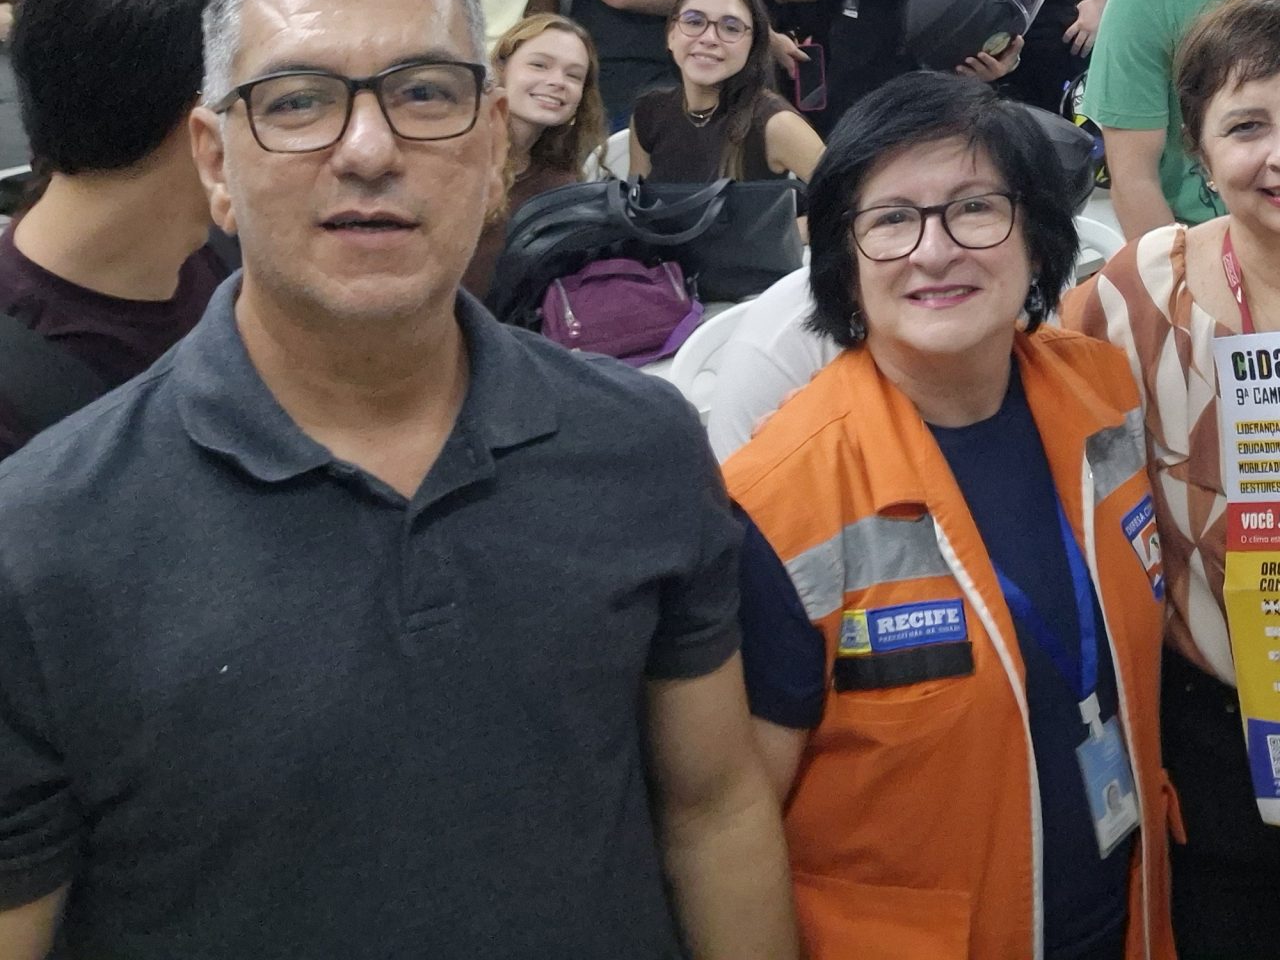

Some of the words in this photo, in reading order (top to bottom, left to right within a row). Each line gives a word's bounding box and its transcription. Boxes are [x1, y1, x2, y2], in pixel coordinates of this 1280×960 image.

[1241, 535, 1247, 543] O
[1249, 535, 1269, 543] clima
[877, 608, 960, 634] RECIFE
